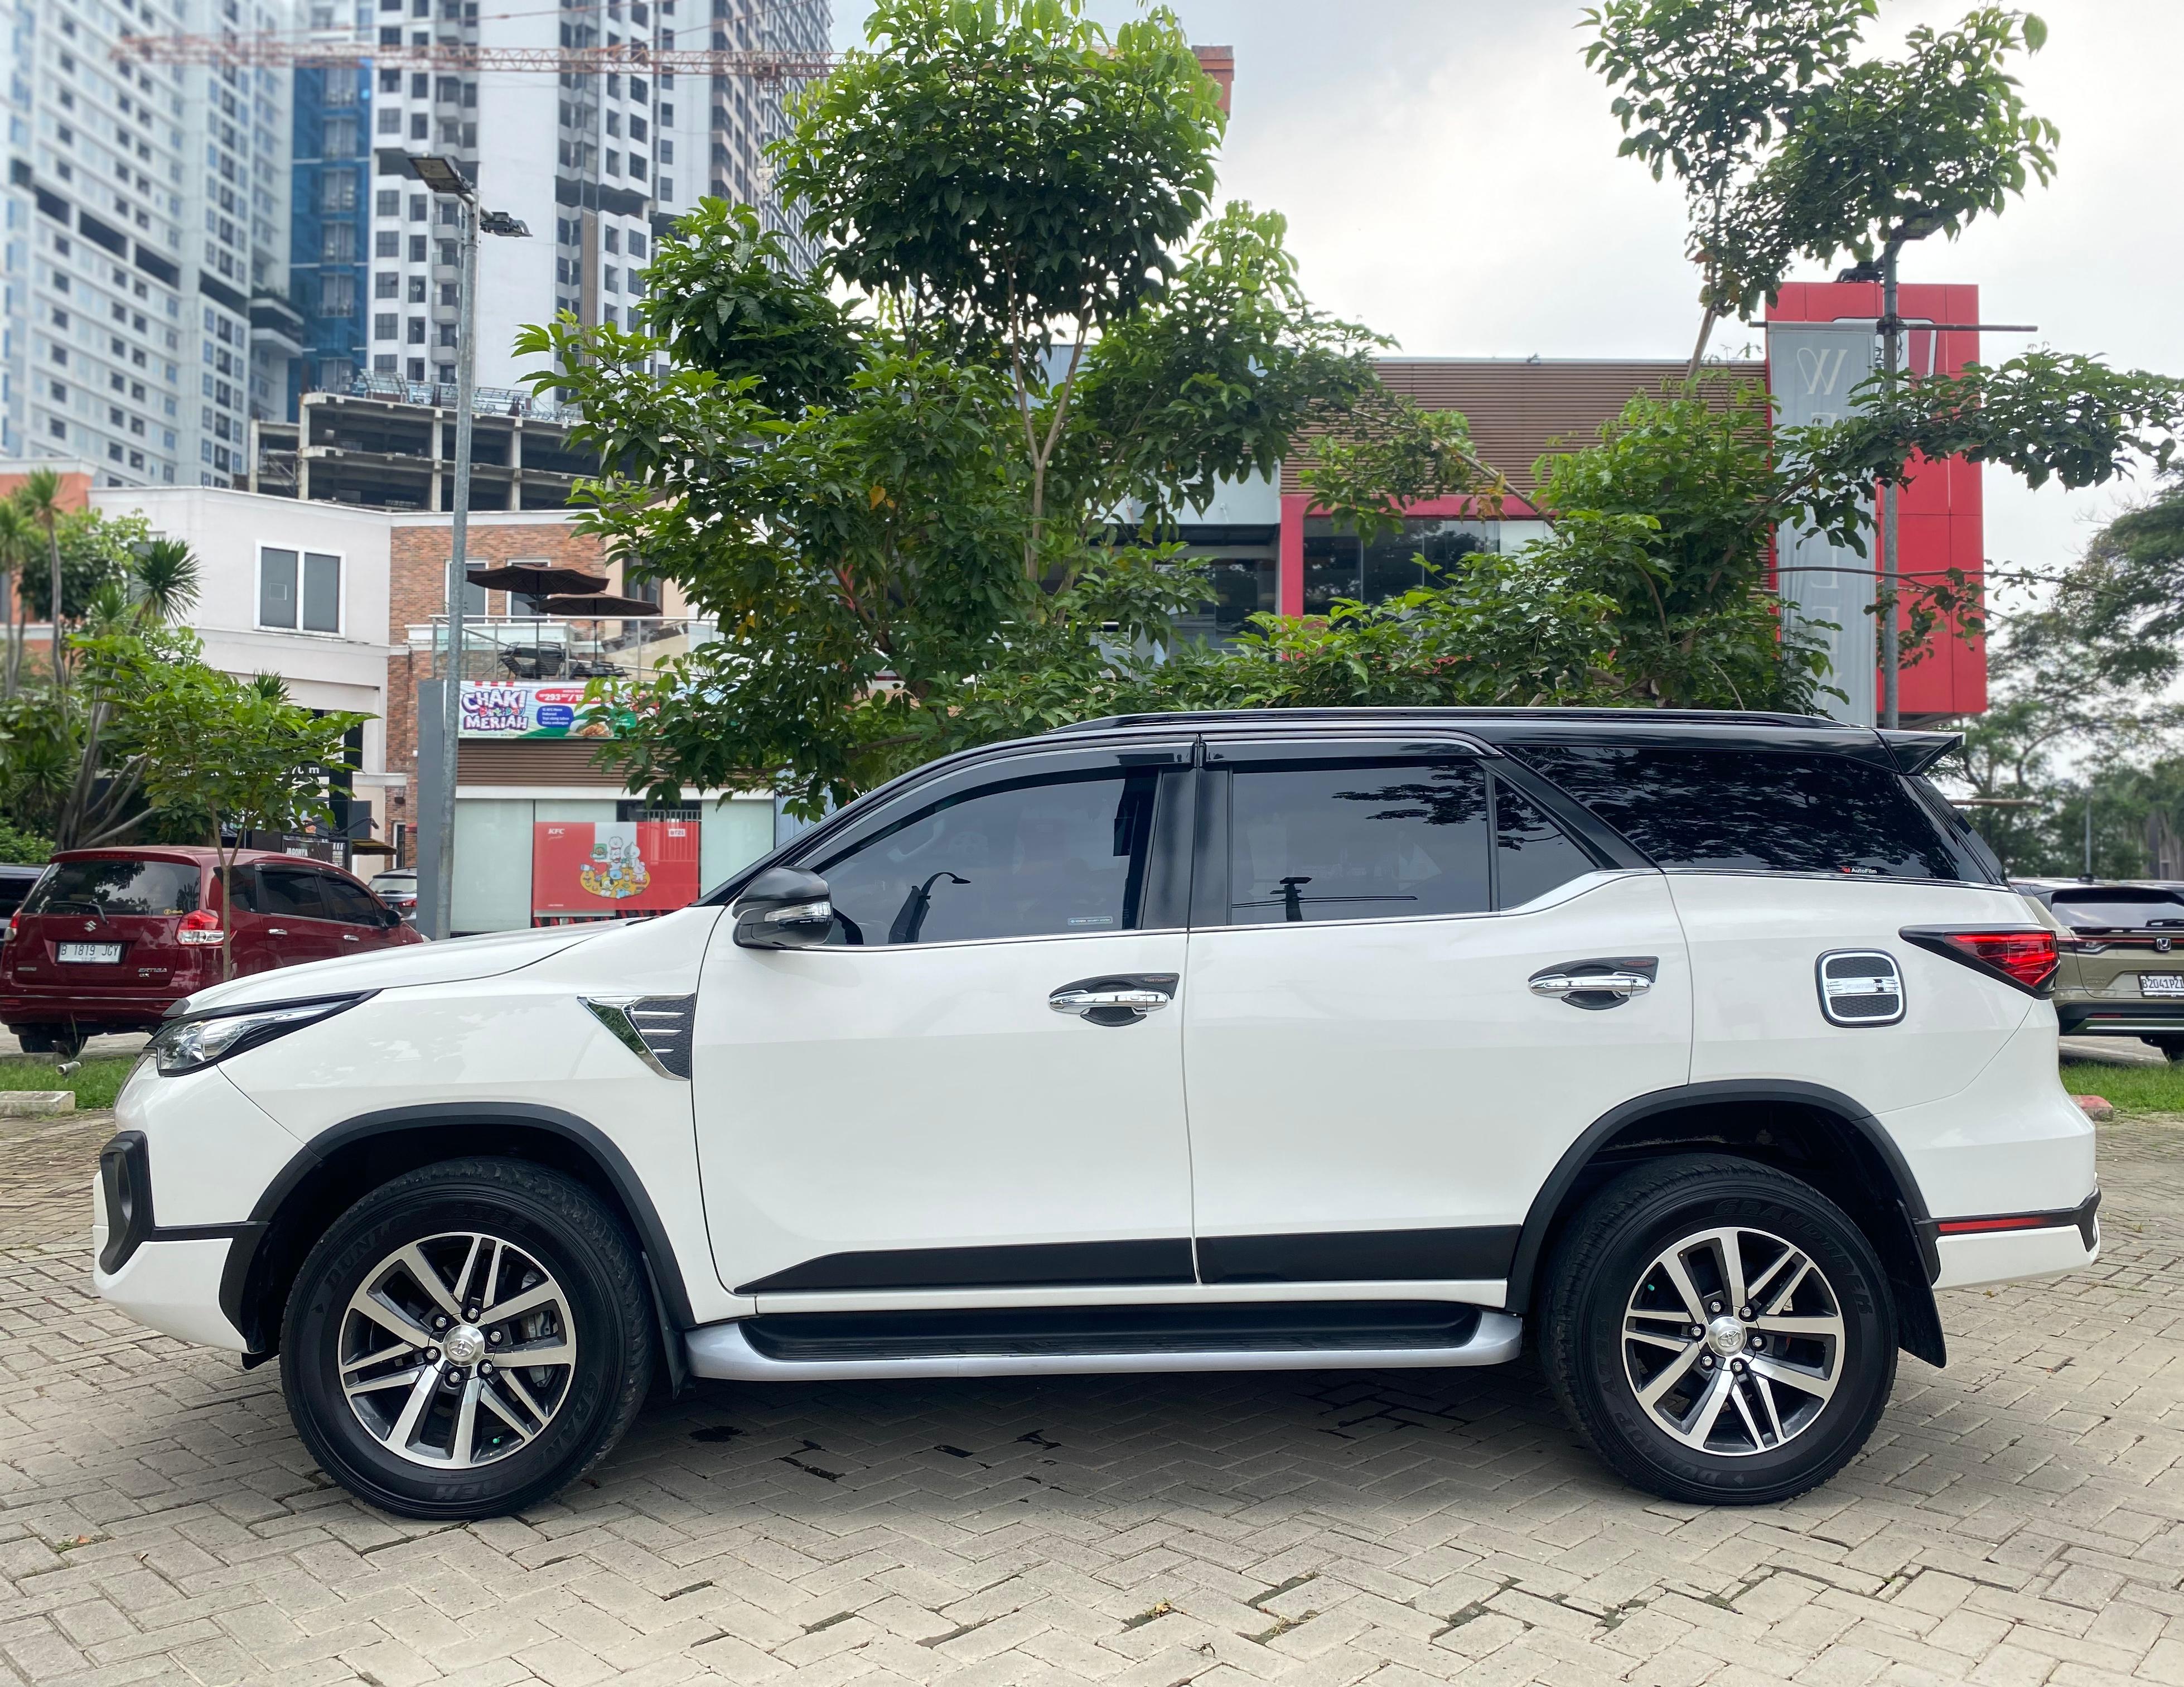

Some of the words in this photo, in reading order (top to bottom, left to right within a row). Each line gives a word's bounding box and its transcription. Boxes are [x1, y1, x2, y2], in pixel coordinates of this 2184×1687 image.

[462, 689, 526, 712] CHAKI
[465, 715, 528, 730] MERIAH
[61, 945, 67, 956] B
[74, 945, 95, 956] 1819
[102, 945, 119, 956] JGY
